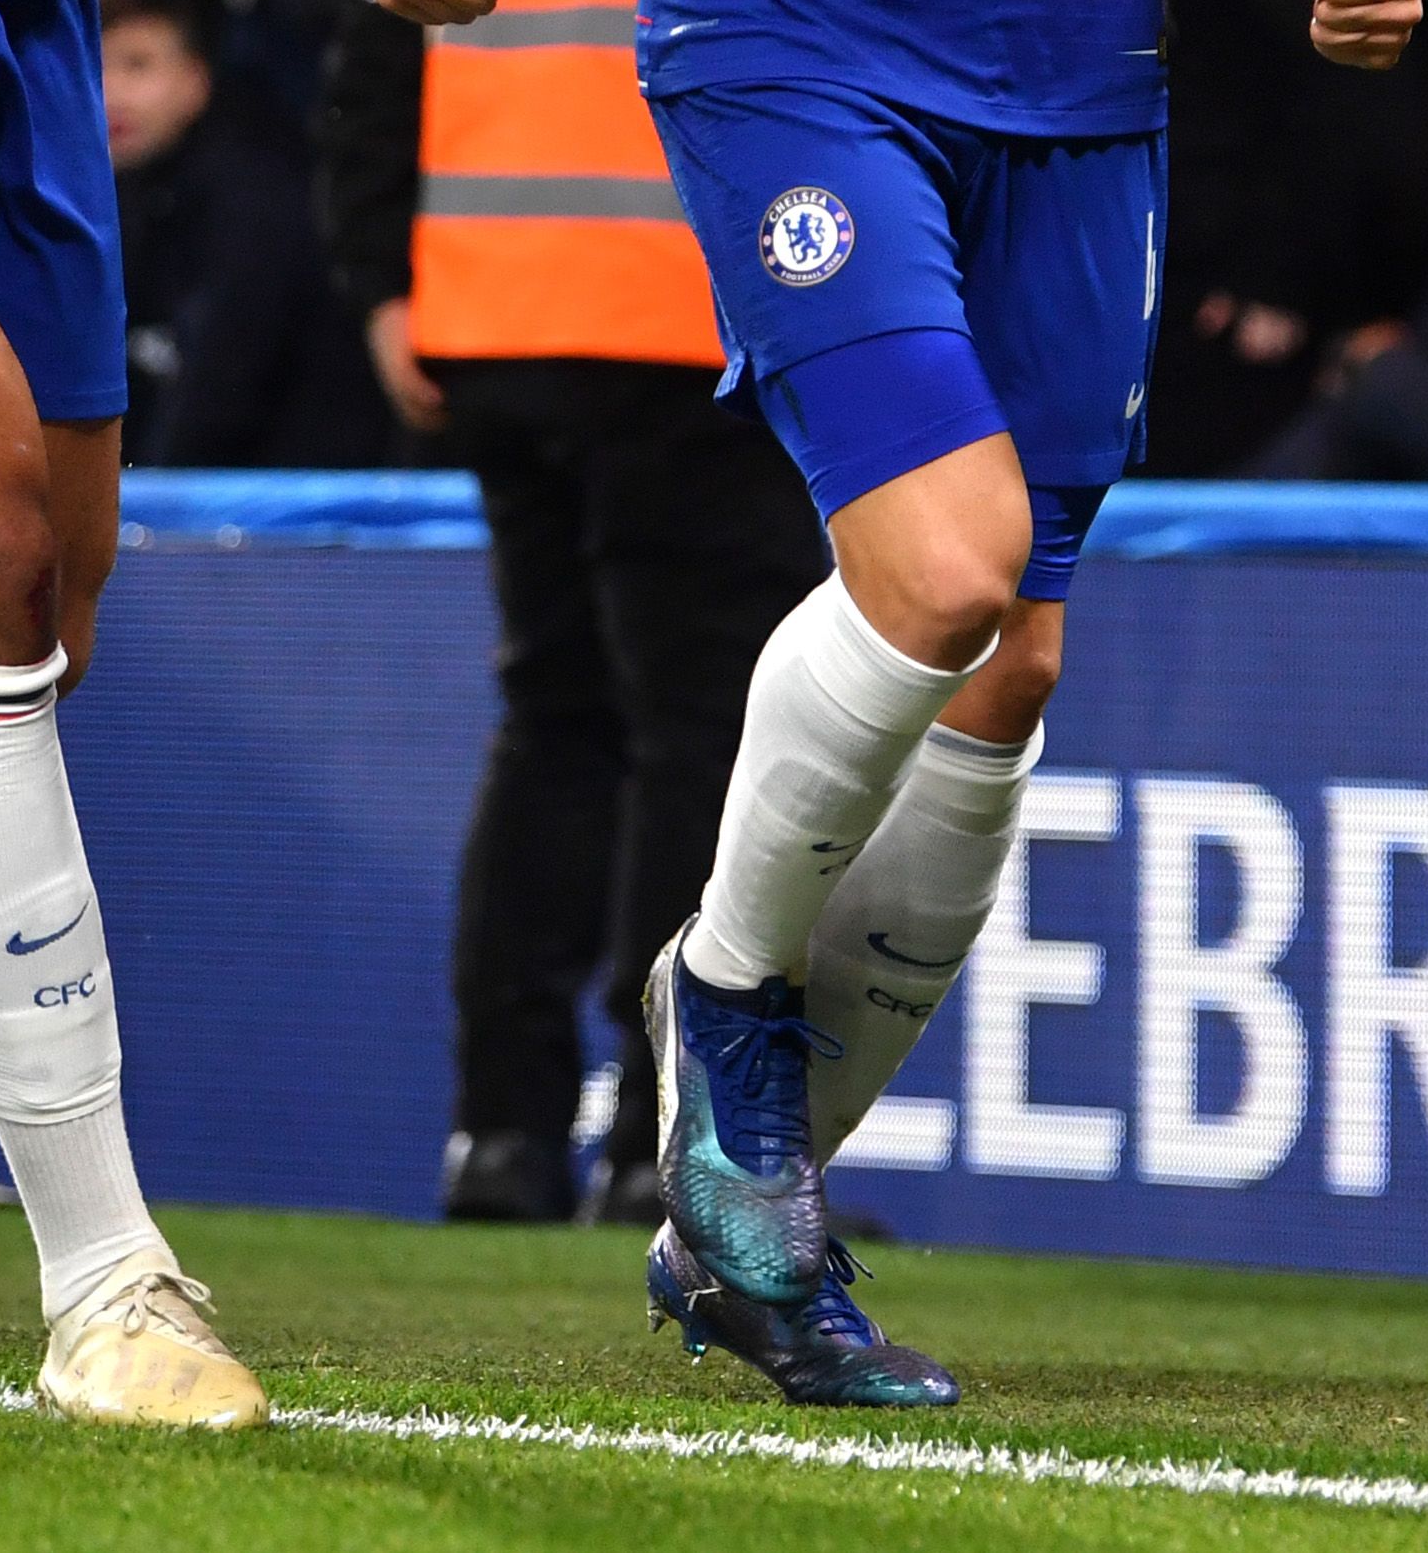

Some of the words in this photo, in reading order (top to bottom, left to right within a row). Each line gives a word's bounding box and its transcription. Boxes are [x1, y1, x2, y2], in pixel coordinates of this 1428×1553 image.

[768, 191, 827, 223] CHELSEA
[33, 972, 96, 1008] CFC
[865, 987, 935, 1018] CFC
